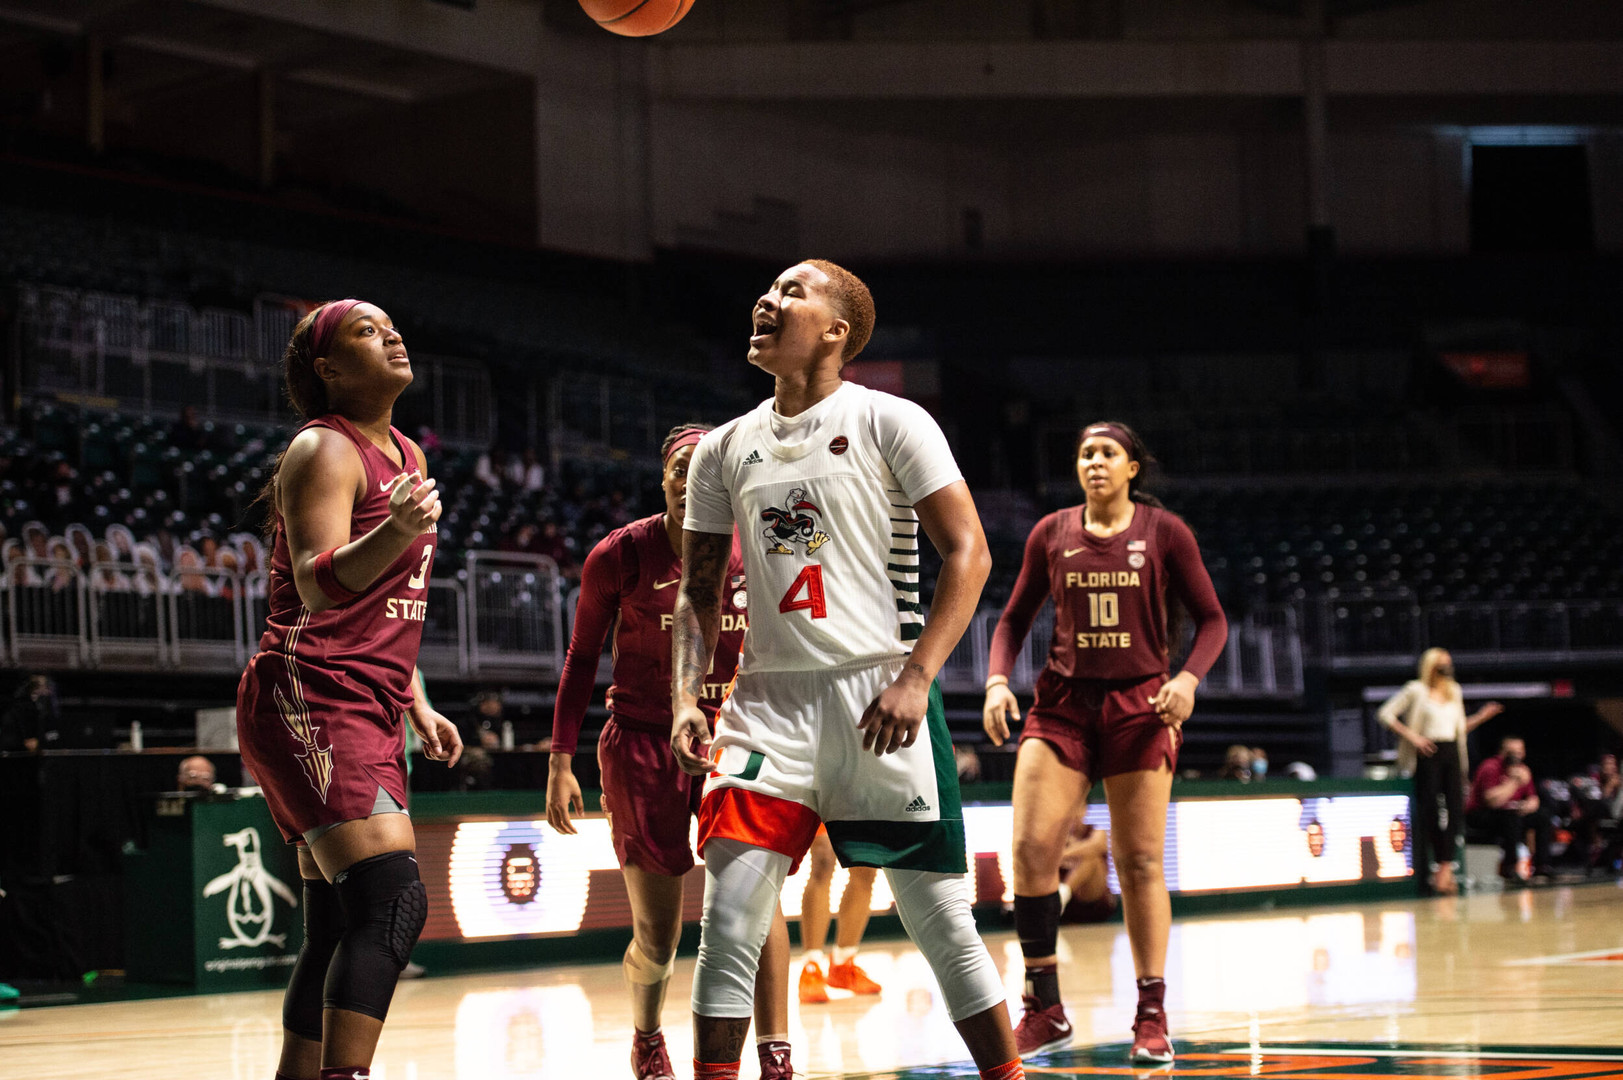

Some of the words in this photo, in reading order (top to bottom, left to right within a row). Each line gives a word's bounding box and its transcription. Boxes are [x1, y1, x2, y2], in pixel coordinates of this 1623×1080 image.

[408, 544, 433, 589] 3
[1066, 571, 1141, 589] FLORIDA
[779, 564, 827, 620] 4
[1087, 592, 1120, 628] 10
[1077, 632, 1132, 649] STATE
[905, 804, 931, 812] adidas
